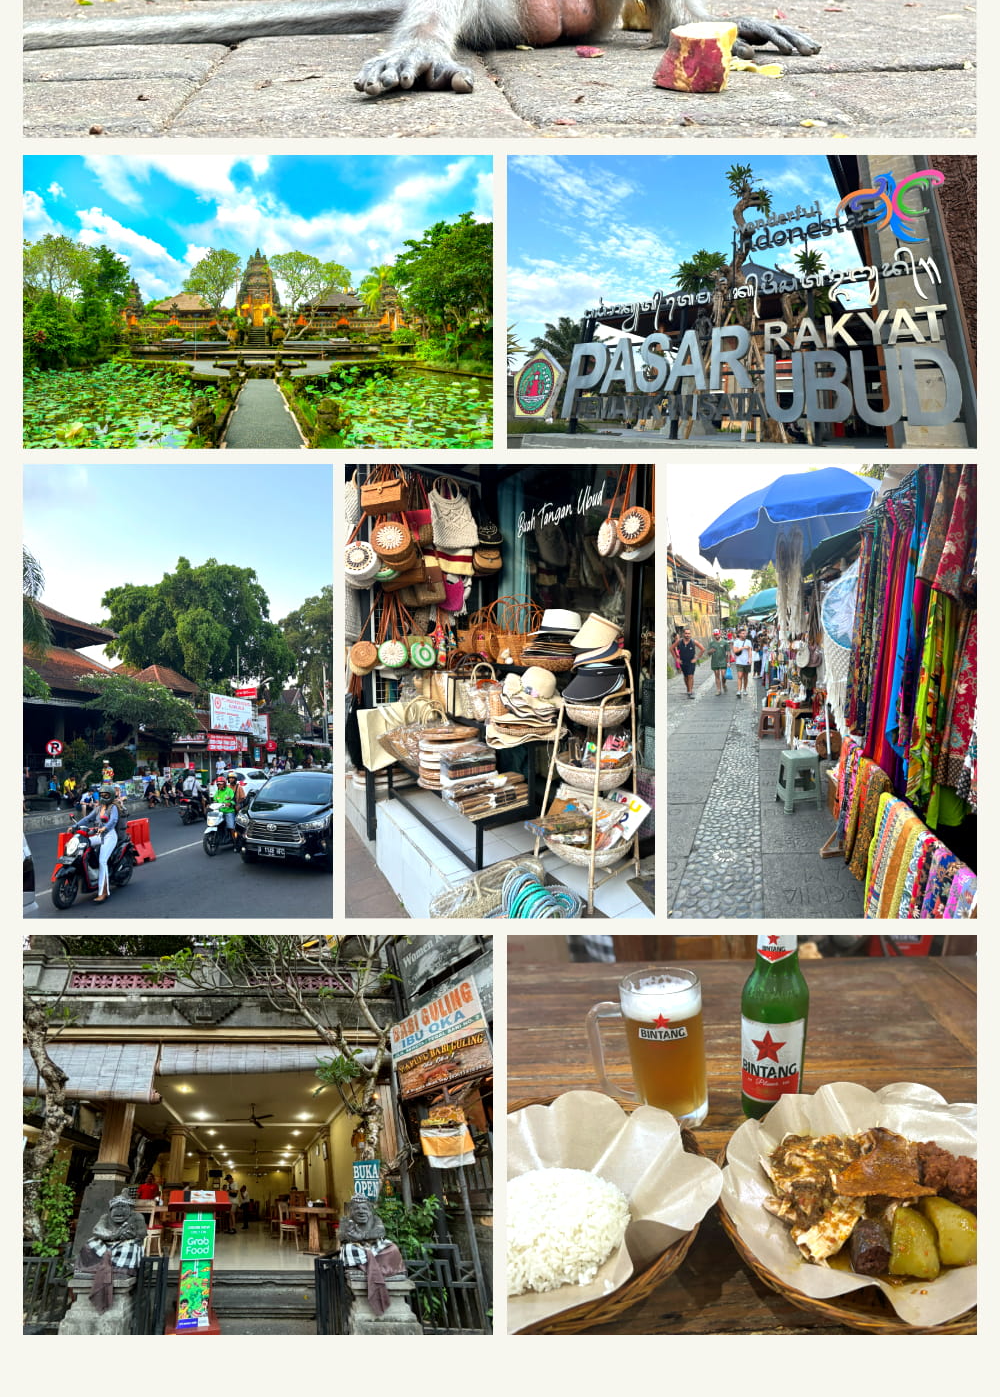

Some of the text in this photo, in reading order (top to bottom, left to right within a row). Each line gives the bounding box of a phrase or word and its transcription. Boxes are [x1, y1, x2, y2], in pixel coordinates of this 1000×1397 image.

[732, 200, 821, 234] wonderful
[731, 215, 862, 253] indonesia
[763, 303, 948, 352] RAKYAT
[561, 324, 755, 419] PASAR
[764, 346, 963, 427] UBUD
[537, 502, 573, 530] Tangan
[577, 479, 606, 517] Ubud
[402, 940, 434, 967] Women
[393, 982, 474, 1043] BABI GULING
[401, 1029, 424, 1048] IBU
[428, 1010, 466, 1034] OKA
[640, 1027, 685, 1040] BINTANG
[429, 1045, 449, 1058] BABI
[451, 1033, 484, 1051] GULING
[742, 1057, 797, 1079] BINTANG
[353, 1163, 379, 1179] BUKA
[354, 1180, 379, 1197] OPEN
[185, 1245, 210, 1256] Food
[187, 1236, 210, 1246] Grab
